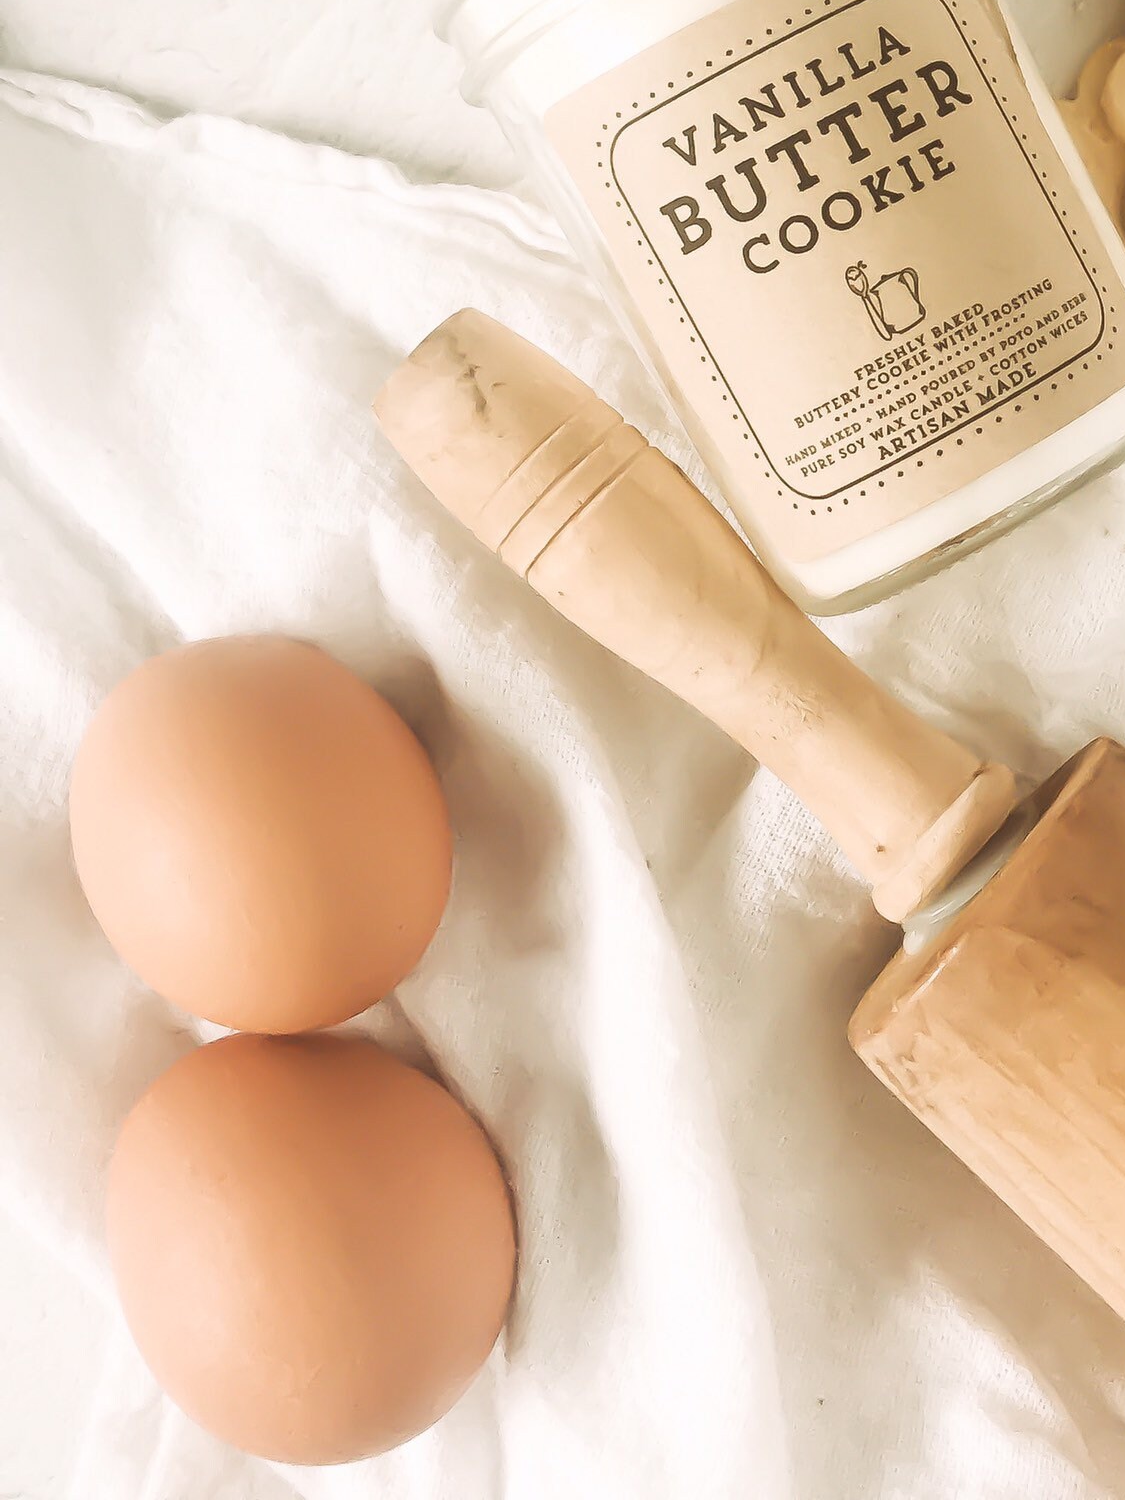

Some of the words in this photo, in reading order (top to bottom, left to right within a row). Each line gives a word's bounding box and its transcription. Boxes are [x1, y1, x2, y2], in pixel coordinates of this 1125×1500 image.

[659, 60, 973, 255] BUTTER
[663, 26, 910, 167] VANILLA
[742, 139, 956, 274] COOKIE
[785, 444, 817, 465] HAND
[822, 422, 861, 449] MIXED
[876, 393, 916, 419] HAND
[921, 360, 975, 395] POURED
[980, 347, 995, 362] BY
[1000, 327, 1033, 350] POTO
[1037, 309, 1060, 330] AND
[794, 386, 861, 428] BUTTERY
[867, 349, 931, 391] COOKIE
[933, 323, 978, 352] WITH
[982, 279, 1052, 327] FROSTING
[800, 455, 835, 477] PURE
[839, 438, 866, 458] SOY
[870, 418, 906, 441] WAX
[911, 381, 973, 420] CANDLE
[990, 337, 1047, 375] COTTON
[1050, 311, 1089, 338] WICKS
[854, 333, 925, 380] FRESHLY
[931, 303, 984, 339] BAKED
[879, 401, 971, 460] ARTISAN
[975, 362, 1037, 405] MADE
